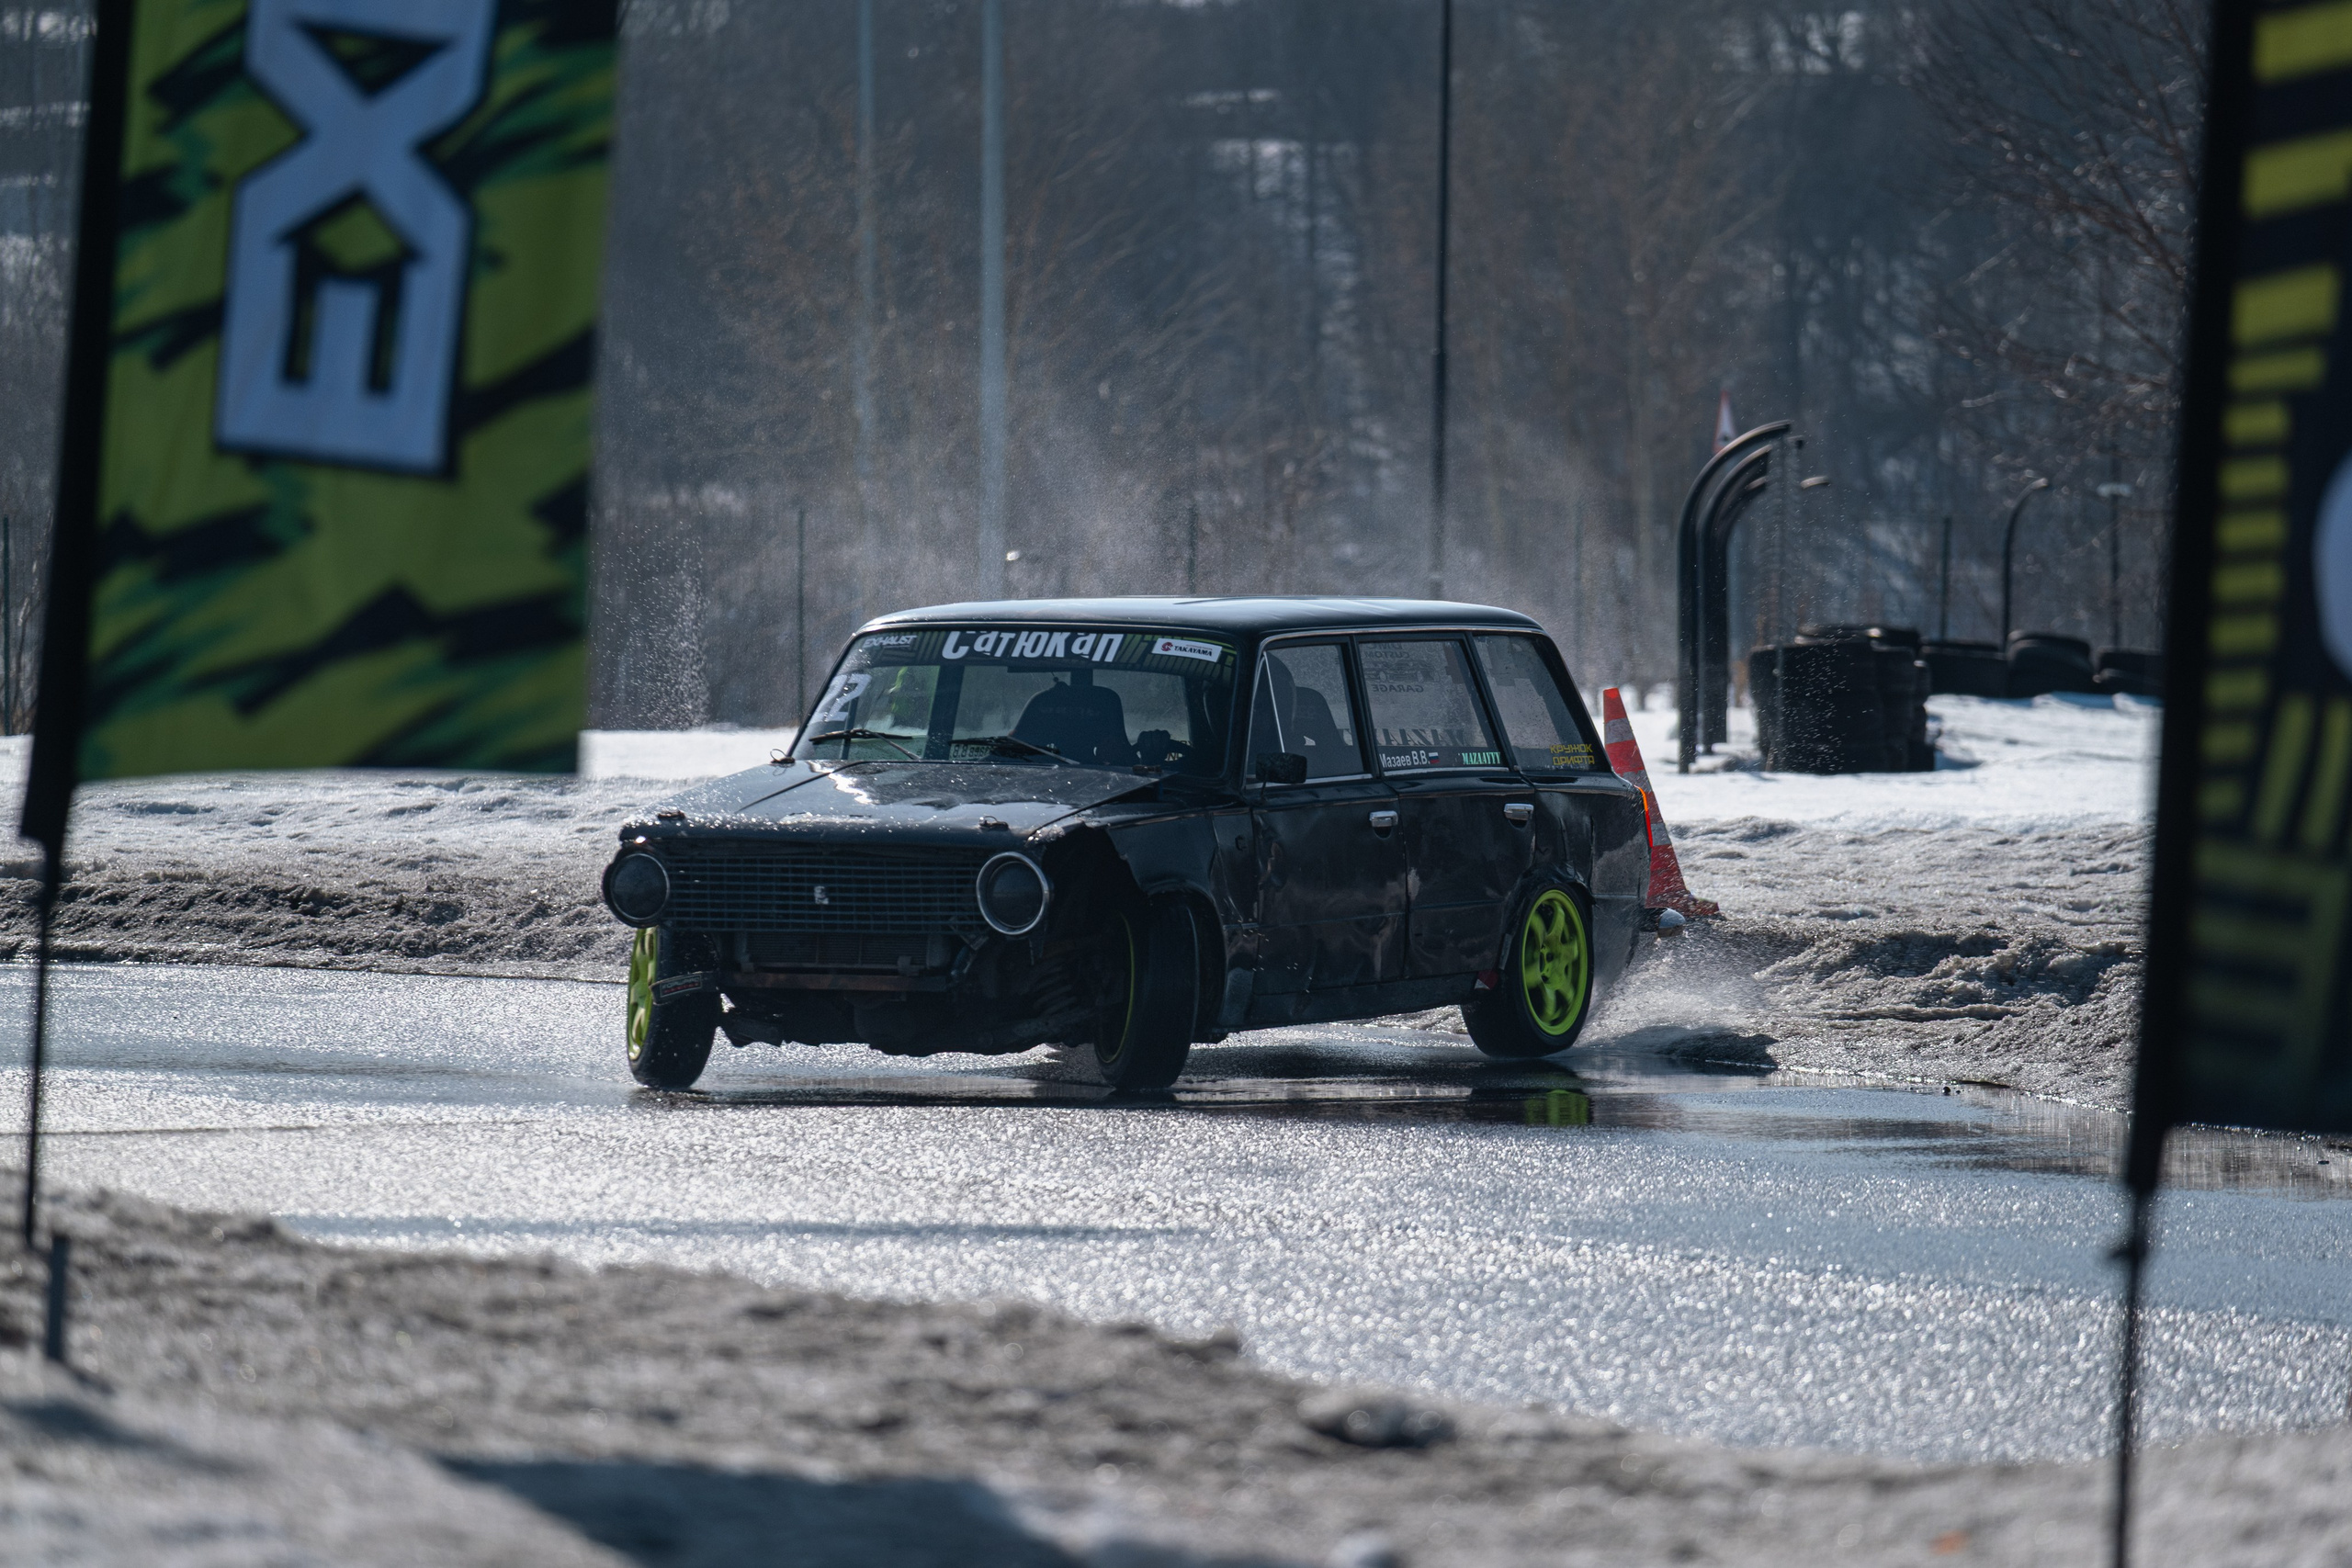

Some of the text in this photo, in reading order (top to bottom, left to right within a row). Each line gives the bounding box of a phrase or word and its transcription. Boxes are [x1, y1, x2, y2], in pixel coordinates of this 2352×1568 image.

[218, 0, 496, 472] EX
[862, 635, 917, 649] EXHAUST
[1174, 645, 1213, 657] TAKAYAMA
[1550, 743, 1593, 753] КРУЖОК
